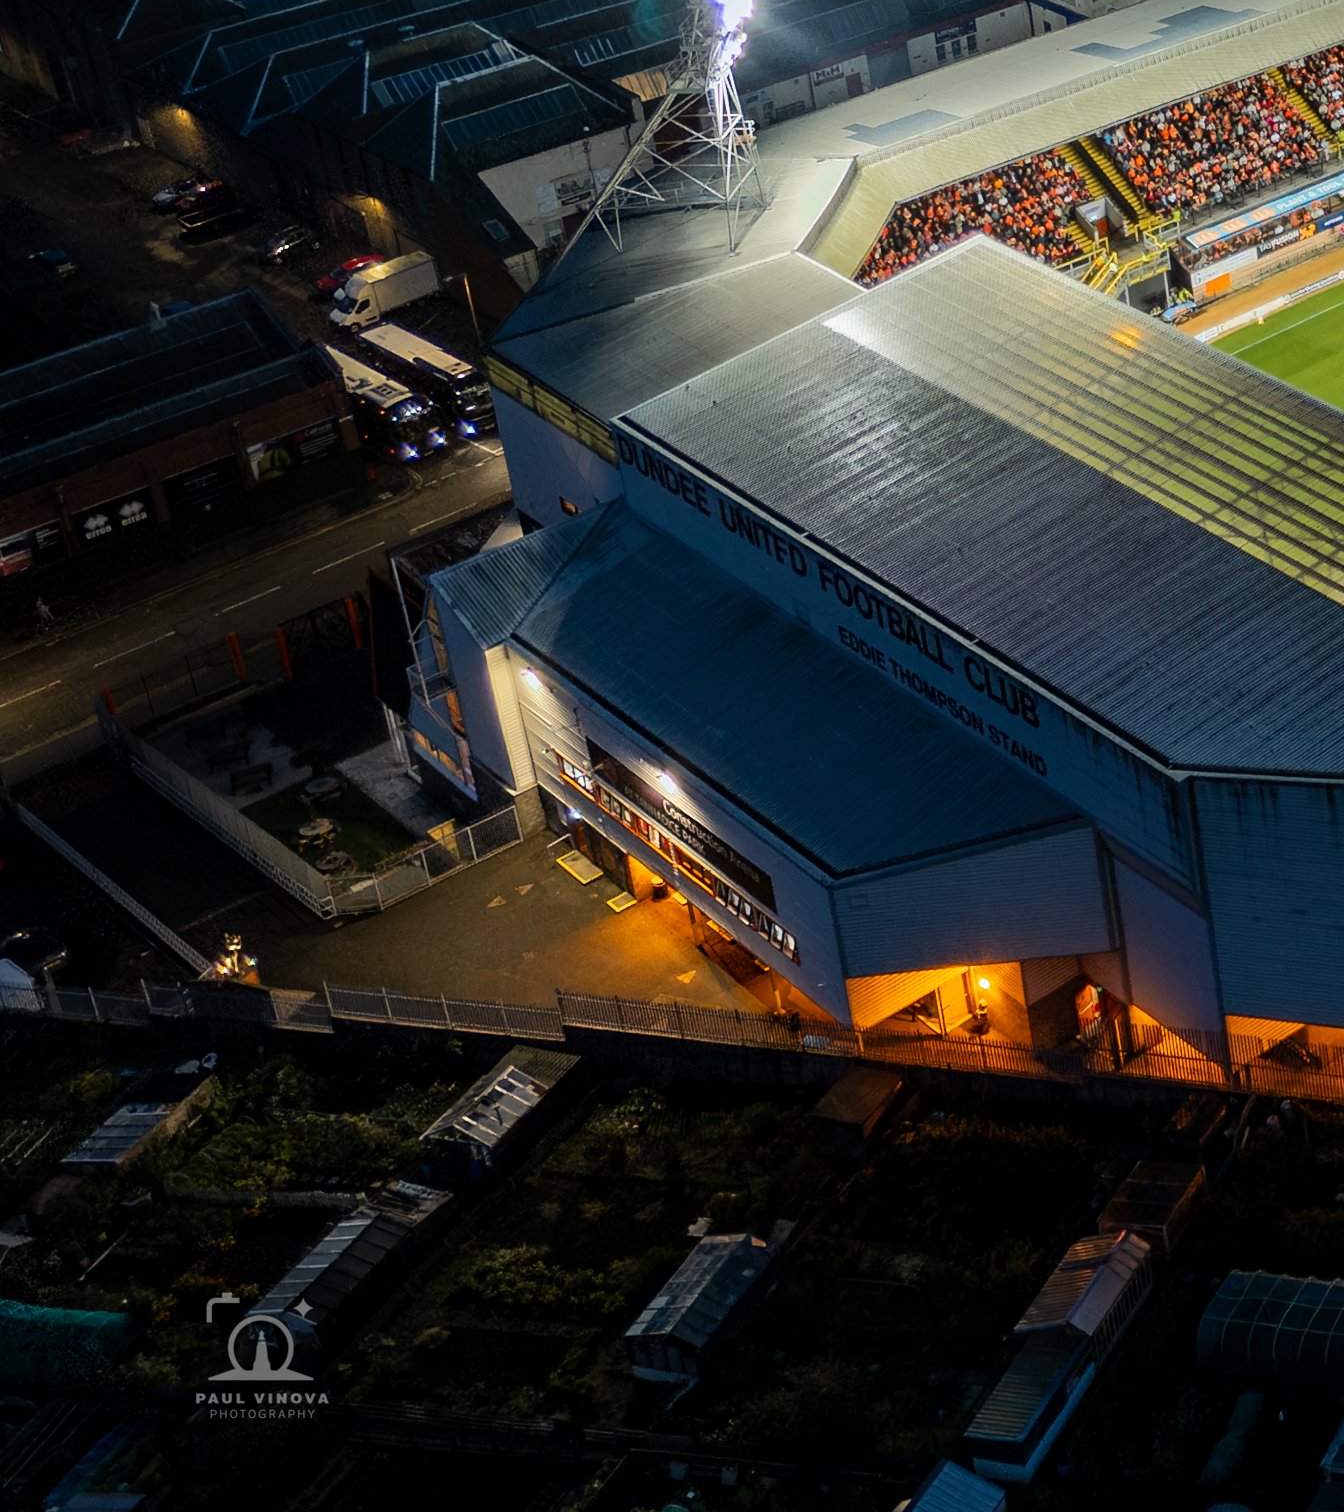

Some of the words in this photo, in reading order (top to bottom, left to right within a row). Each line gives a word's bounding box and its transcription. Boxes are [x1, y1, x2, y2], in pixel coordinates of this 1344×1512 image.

[1259, 229, 1299, 252] TAYFUSION
[616, 430, 711, 517] DUNDEE
[719, 498, 808, 578] UNITED
[818, 558, 954, 674] FOOTBALL
[965, 654, 1040, 729] CLUB
[838, 625, 888, 671] EDDIE
[889, 657, 984, 734] THOMPSON
[987, 723, 1049, 777] STAND
[662, 798, 728, 858] Construction
